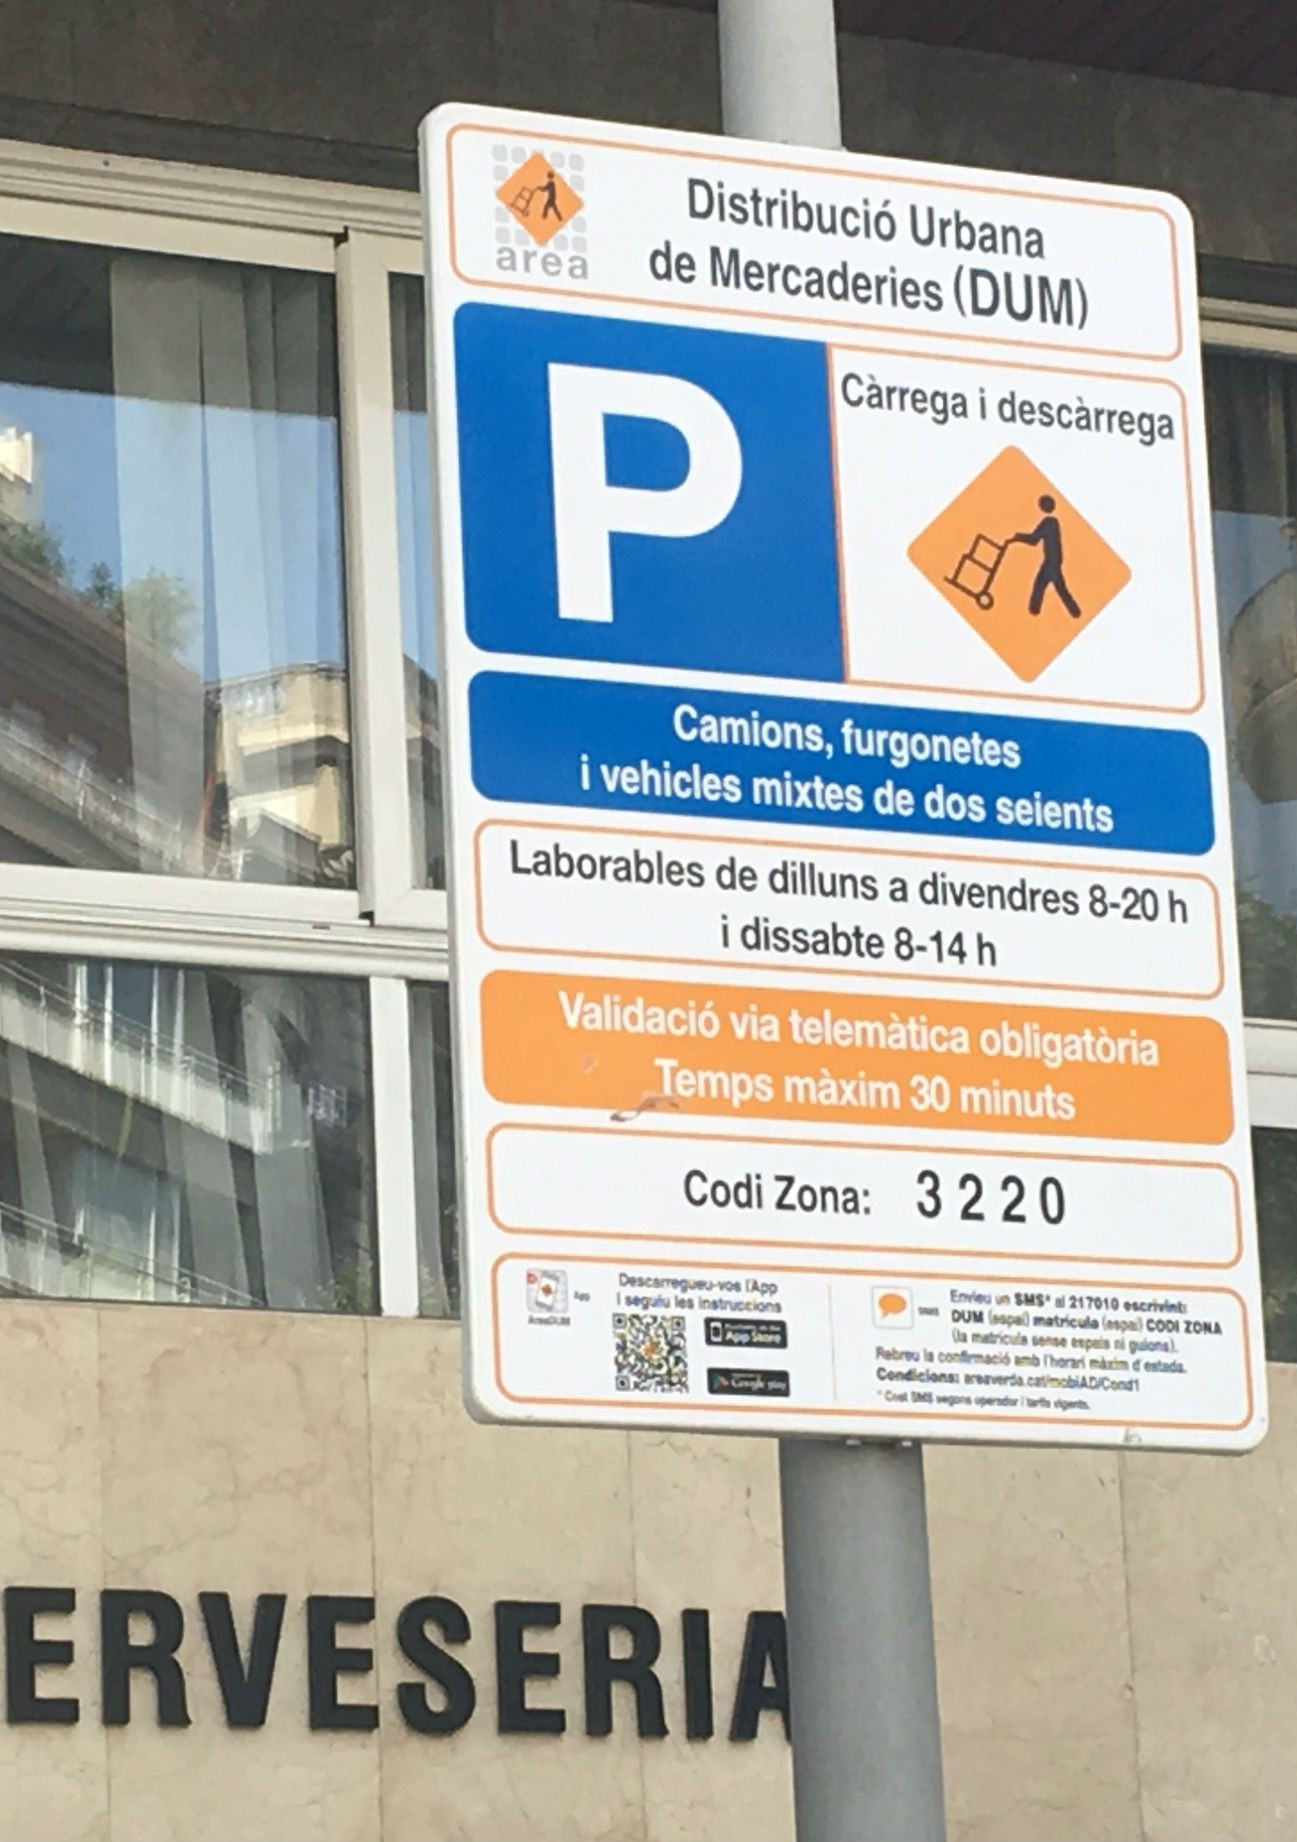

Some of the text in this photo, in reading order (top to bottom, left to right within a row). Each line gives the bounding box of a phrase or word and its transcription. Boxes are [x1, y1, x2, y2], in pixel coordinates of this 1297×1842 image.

[687, 177, 1045, 259] Distribució Urbana
[496, 246, 589, 280] area
[649, 240, 1088, 330] de Mercaderies (DUM)
[841, 372, 1174, 447] Càrrega i descàrrega
[547, 362, 743, 623] P
[673, 703, 1021, 769] Camions, furgonetes
[580, 753, 1114, 833] i vehicles mixtes de dos seients
[510, 839, 1188, 924] Laborables de dilluns a divendres 8-20 h
[721, 913, 997, 967] i dissabte 8-14 h
[558, 990, 1159, 1067] Validació via telemàtica obligatòria
[654, 1057, 1076, 1121] Temps màxim 30 minuts
[683, 1169, 763, 1209] Codi
[774, 1174, 871, 1215] Zona:
[951, 1309, 984, 1324] DUM
[1146, 1318, 1180, 1333] CODI
[1183, 1320, 1223, 1335] ZONA
[1069, 1295, 1120, 1311] 217010
